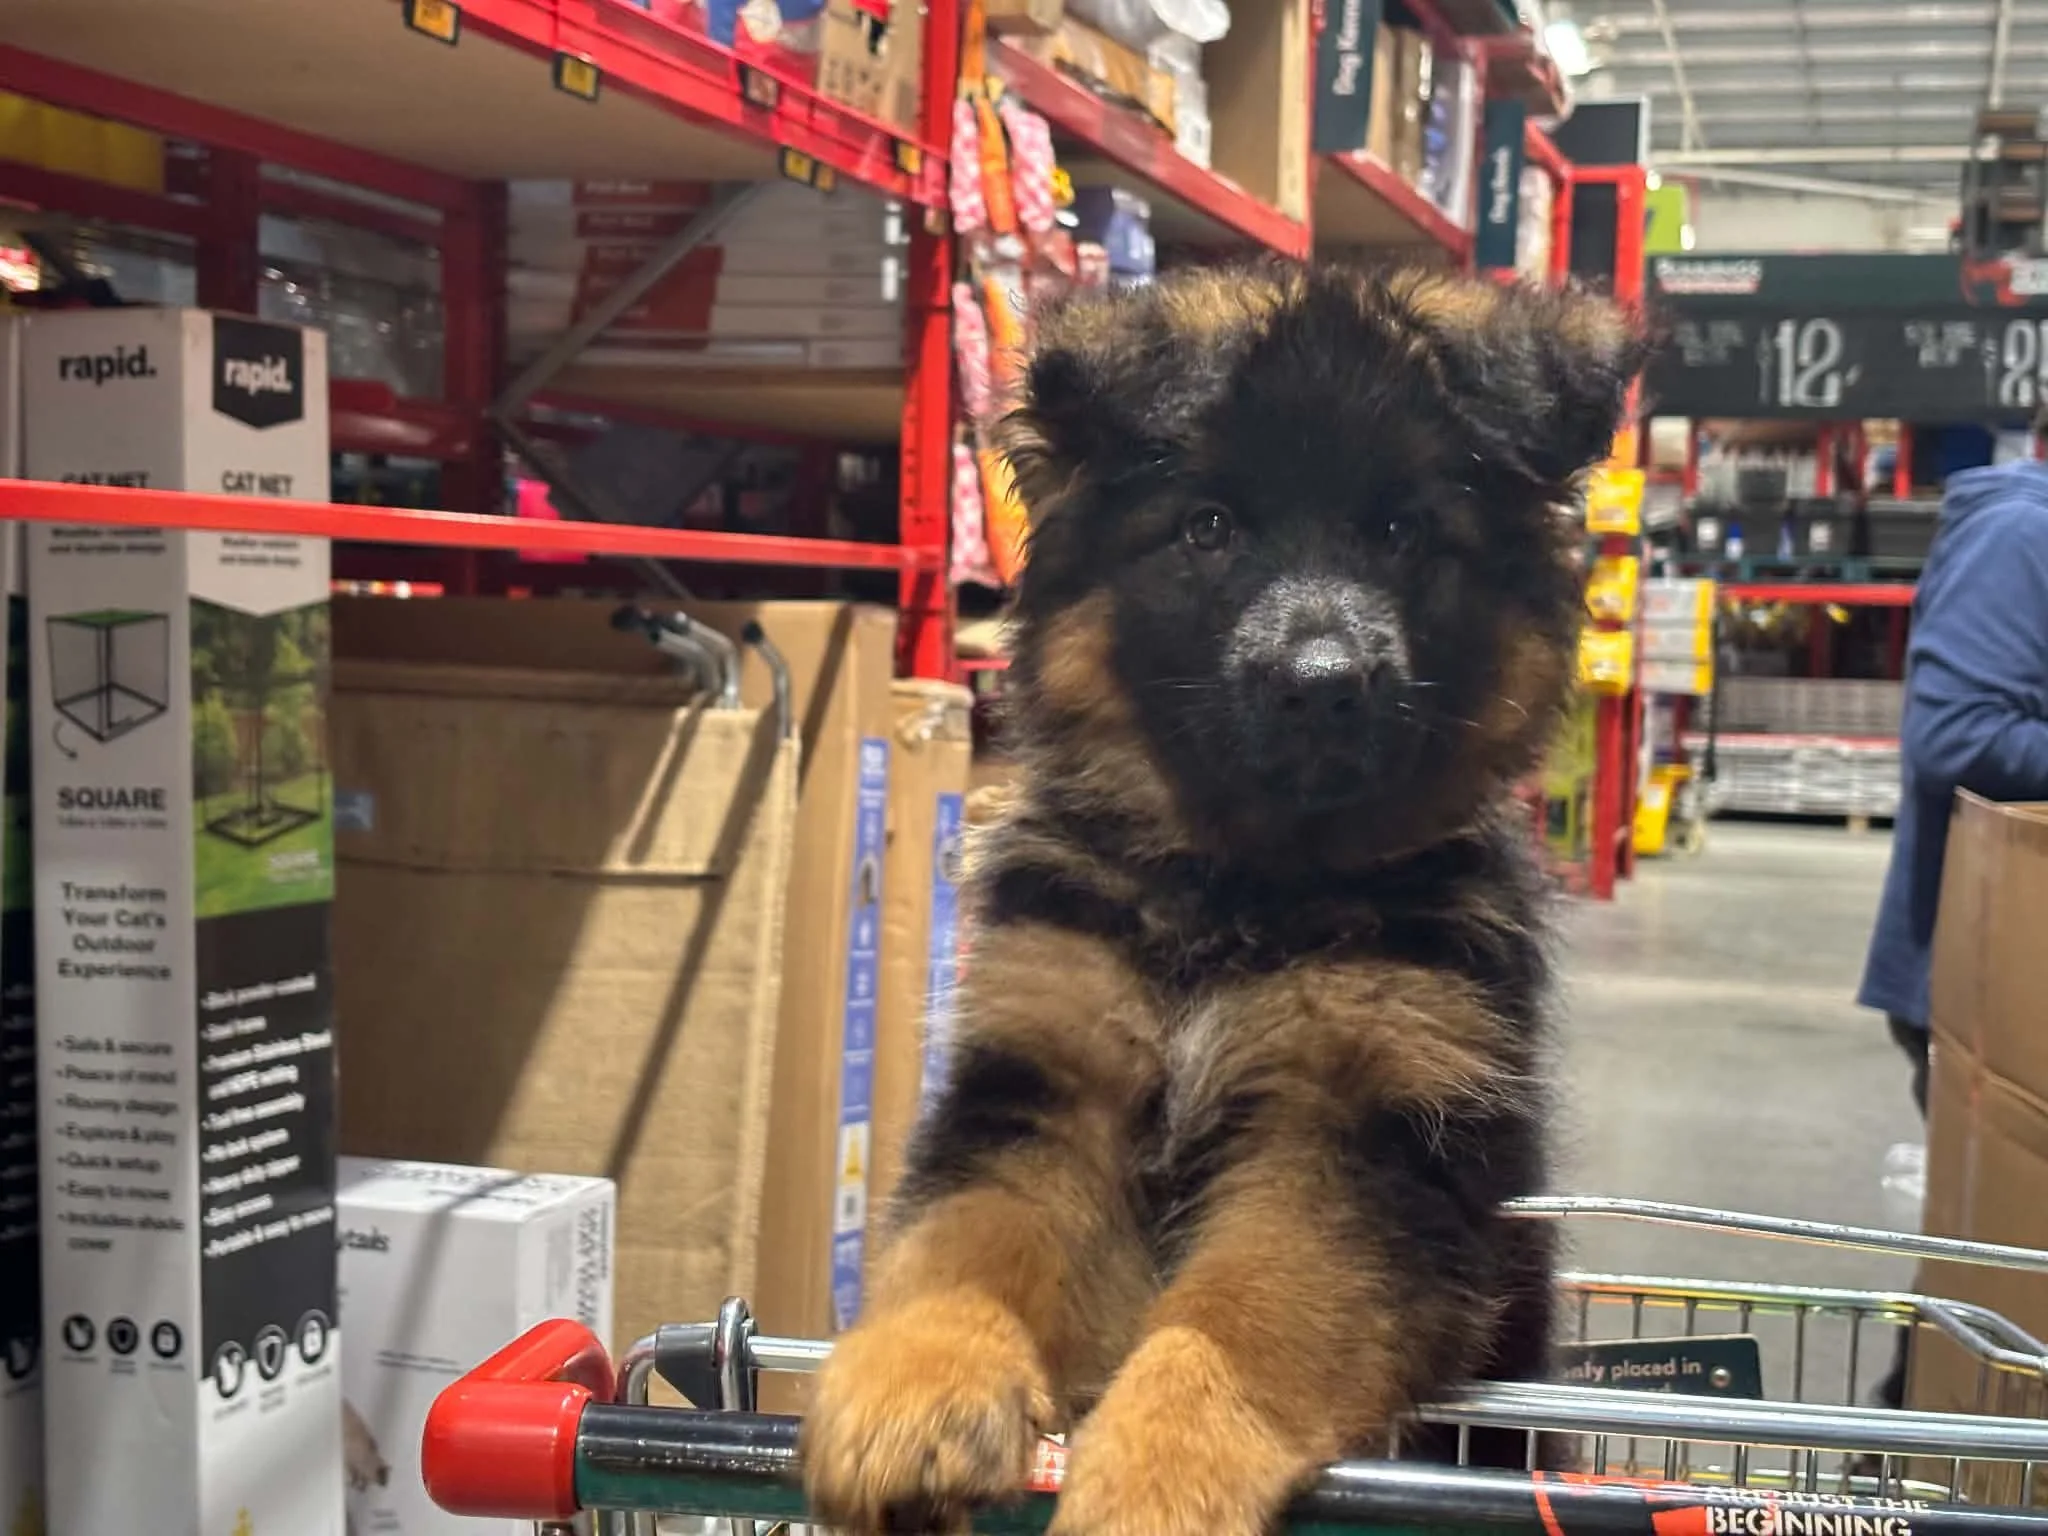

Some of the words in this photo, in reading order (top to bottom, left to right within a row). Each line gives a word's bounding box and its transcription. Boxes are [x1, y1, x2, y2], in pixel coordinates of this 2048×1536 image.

[59, 345, 156, 387] rapid.
[225, 355, 293, 396] rapid.
[221, 471, 254, 493] CAT
[258, 474, 293, 495] NET
[57, 786, 167, 810] SQUARE
[60, 882, 167, 902] Transform
[63, 909, 107, 927] Your
[116, 908, 166, 928] Cat's
[74, 934, 156, 953] Outdoor
[57, 958, 171, 981] Experience
[1611, 1358, 1676, 1380] placed
[1681, 1357, 1702, 1375] in
[1706, 1506, 1912, 1536] BEGINNING
